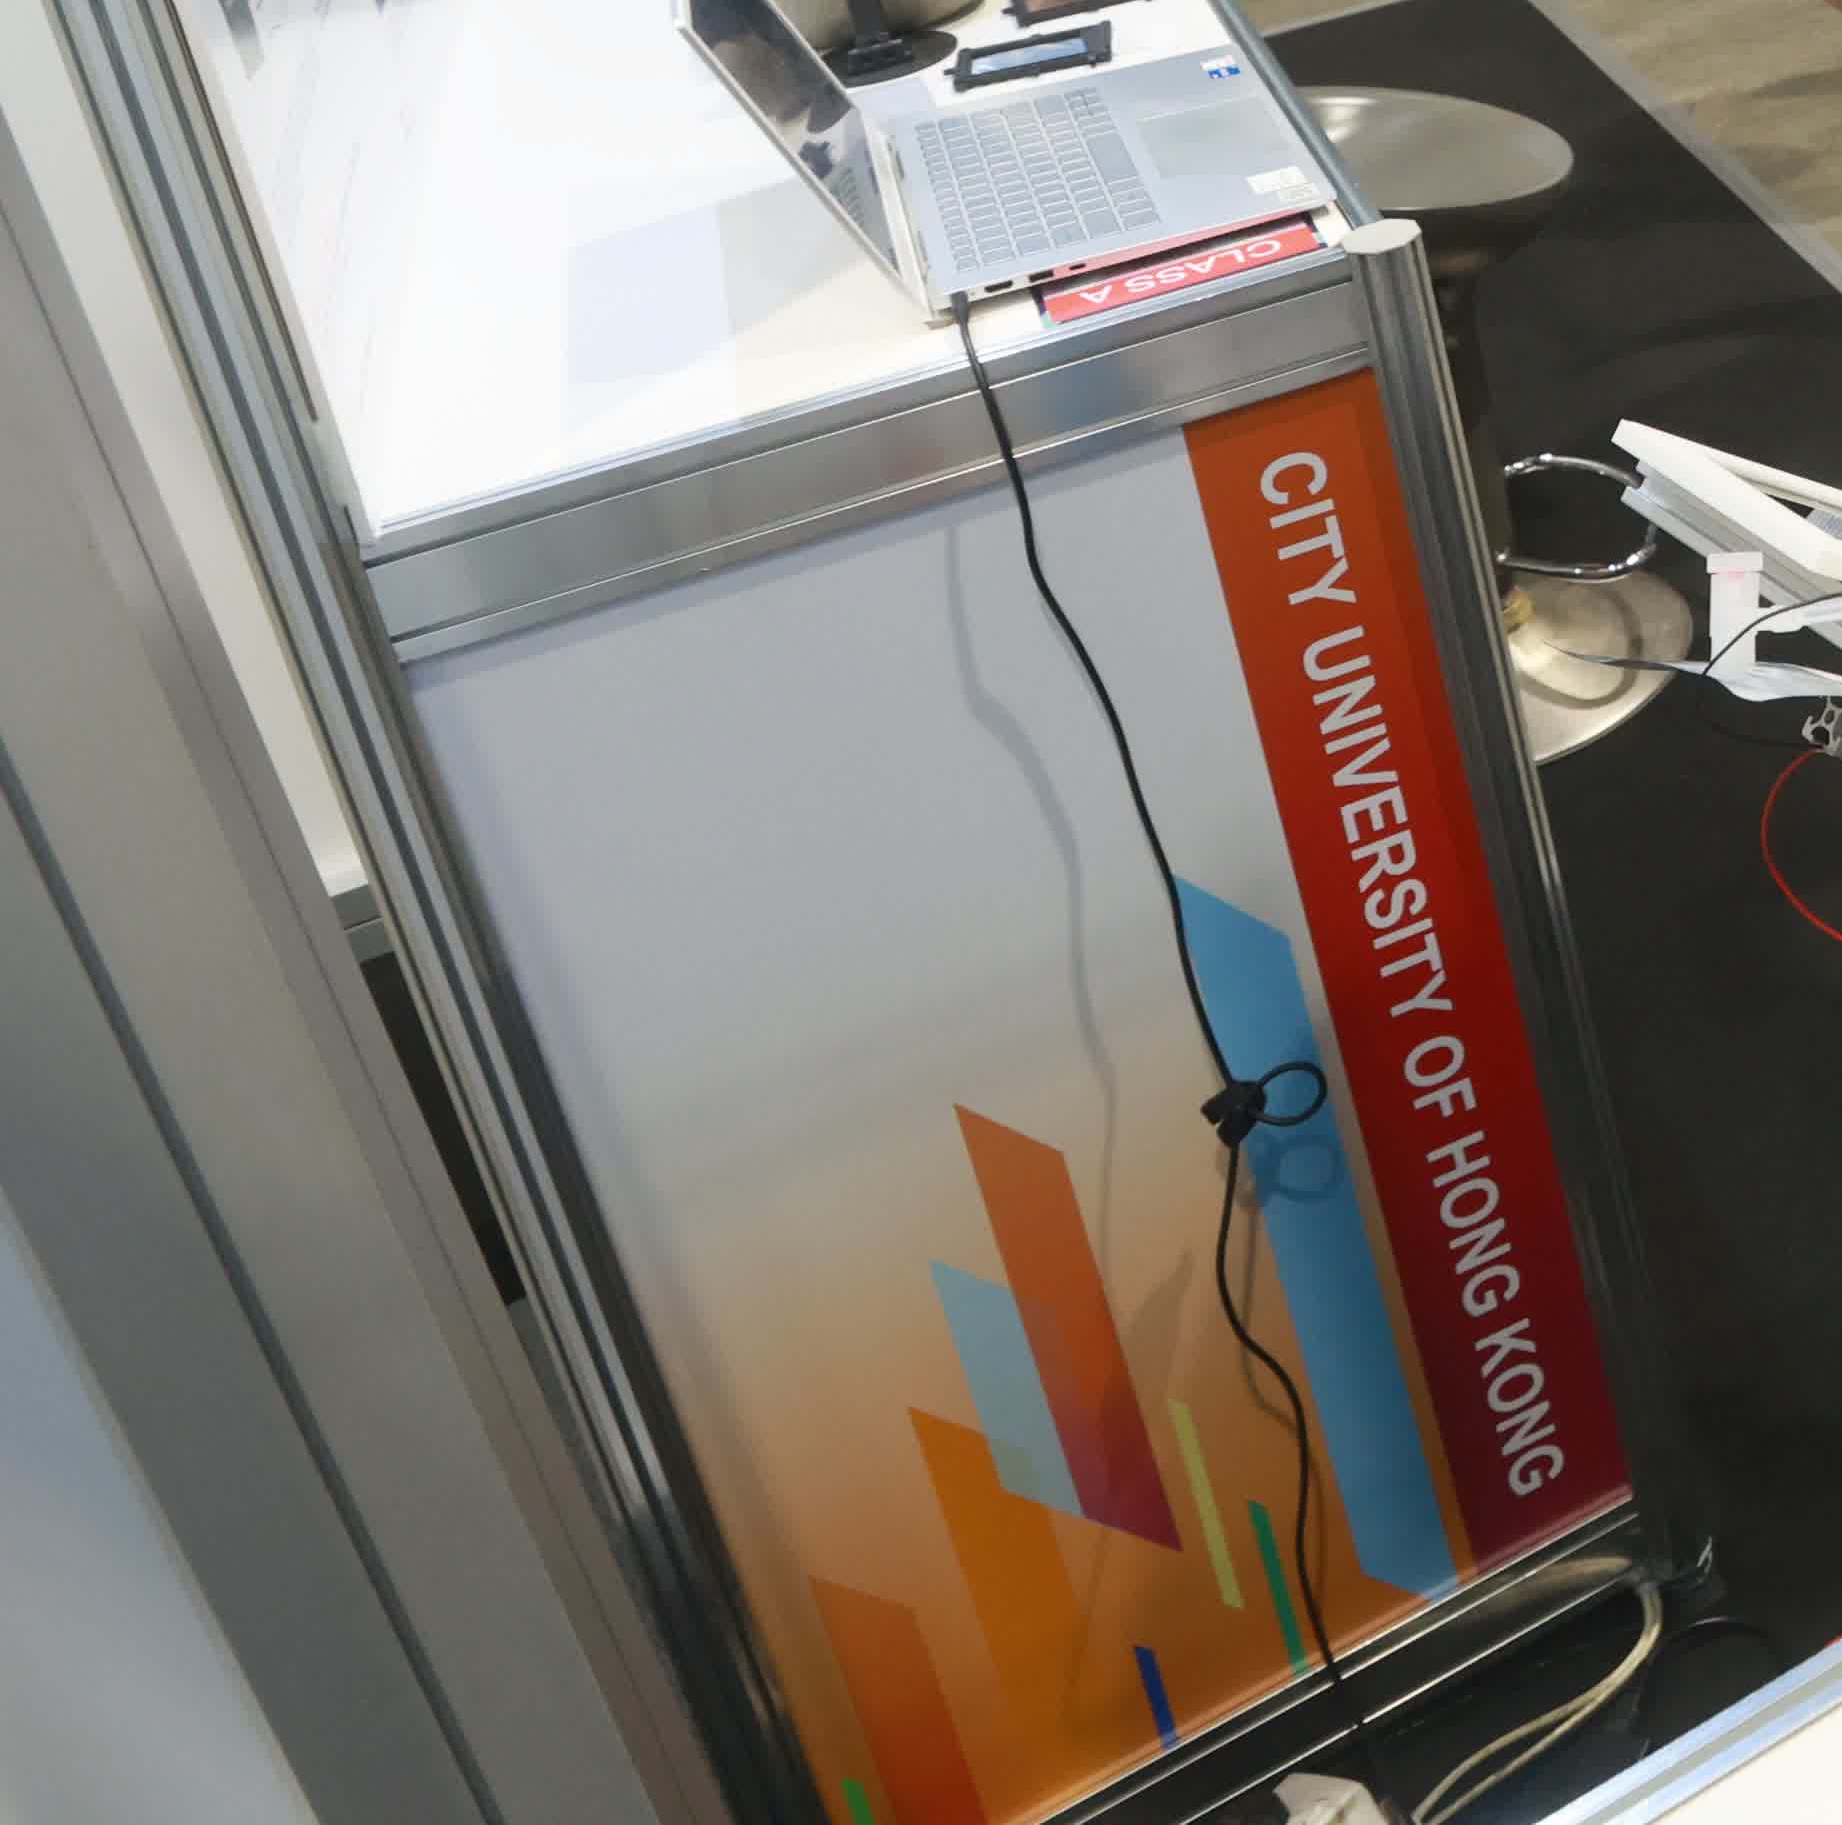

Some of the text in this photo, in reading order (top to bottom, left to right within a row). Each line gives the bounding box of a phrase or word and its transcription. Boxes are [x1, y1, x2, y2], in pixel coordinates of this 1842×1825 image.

[1076, 238, 1282, 305] CLASS A
[1259, 450, 1564, 1495] CITY UNIVERSITY OF HONG KONG
